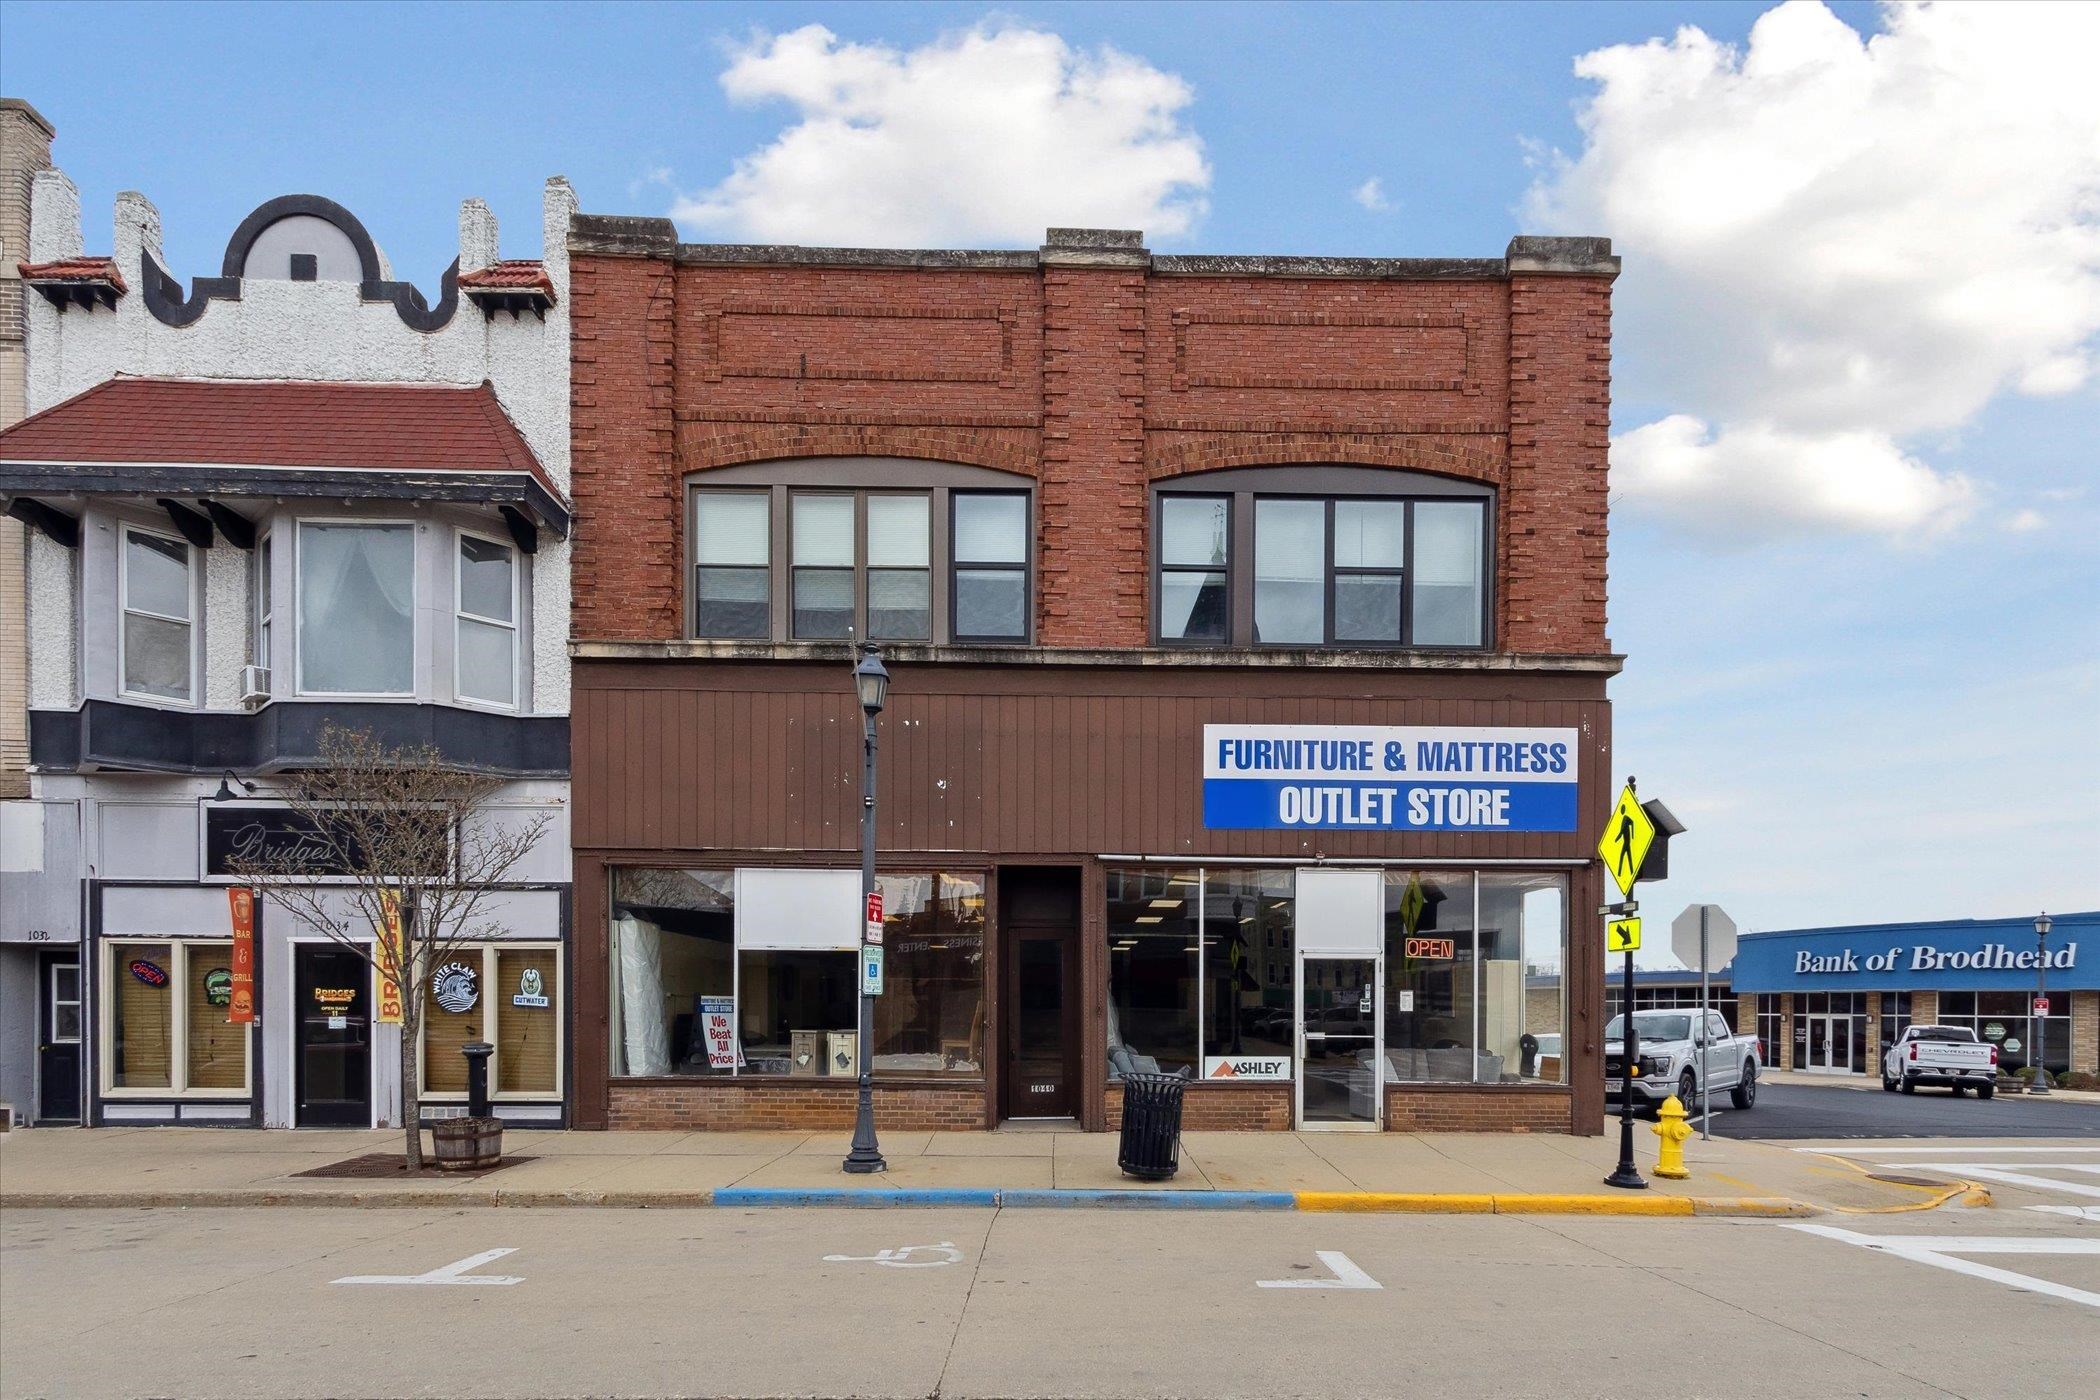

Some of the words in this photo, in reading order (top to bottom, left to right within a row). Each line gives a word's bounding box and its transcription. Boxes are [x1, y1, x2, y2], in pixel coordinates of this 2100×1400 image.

[1218, 738, 1373, 771] FURNITURE
[1383, 740, 1406, 771] &
[1417, 741, 1567, 774] MATTRESS
[1279, 786, 1397, 825] OUTLET
[1408, 788, 1510, 826] STORE
[231, 823, 336, 873] Bridges
[319, 921, 350, 931] 1034
[236, 929, 250, 938] BAR
[1407, 940, 1452, 957] OPEN
[239, 947, 247, 963] &
[1794, 949, 1860, 974] Bank
[1865, 948, 1903, 971] of
[1909, 942, 2078, 970] Brodhead
[132, 963, 165, 984] OPEN
[233, 973, 252, 981] GRILL
[433, 964, 452, 994] WHITE
[450, 962, 477, 979] CLAW
[315, 988, 356, 997] BRIDGES
[515, 996, 545, 1005] CUTWATER
[711, 1016, 727, 1027] We
[709, 1028, 732, 1039] Beat
[717, 1041, 729, 1051] All
[709, 1053, 743, 1064] Price!
[1231, 1062, 1282, 1074] ASHLEY
